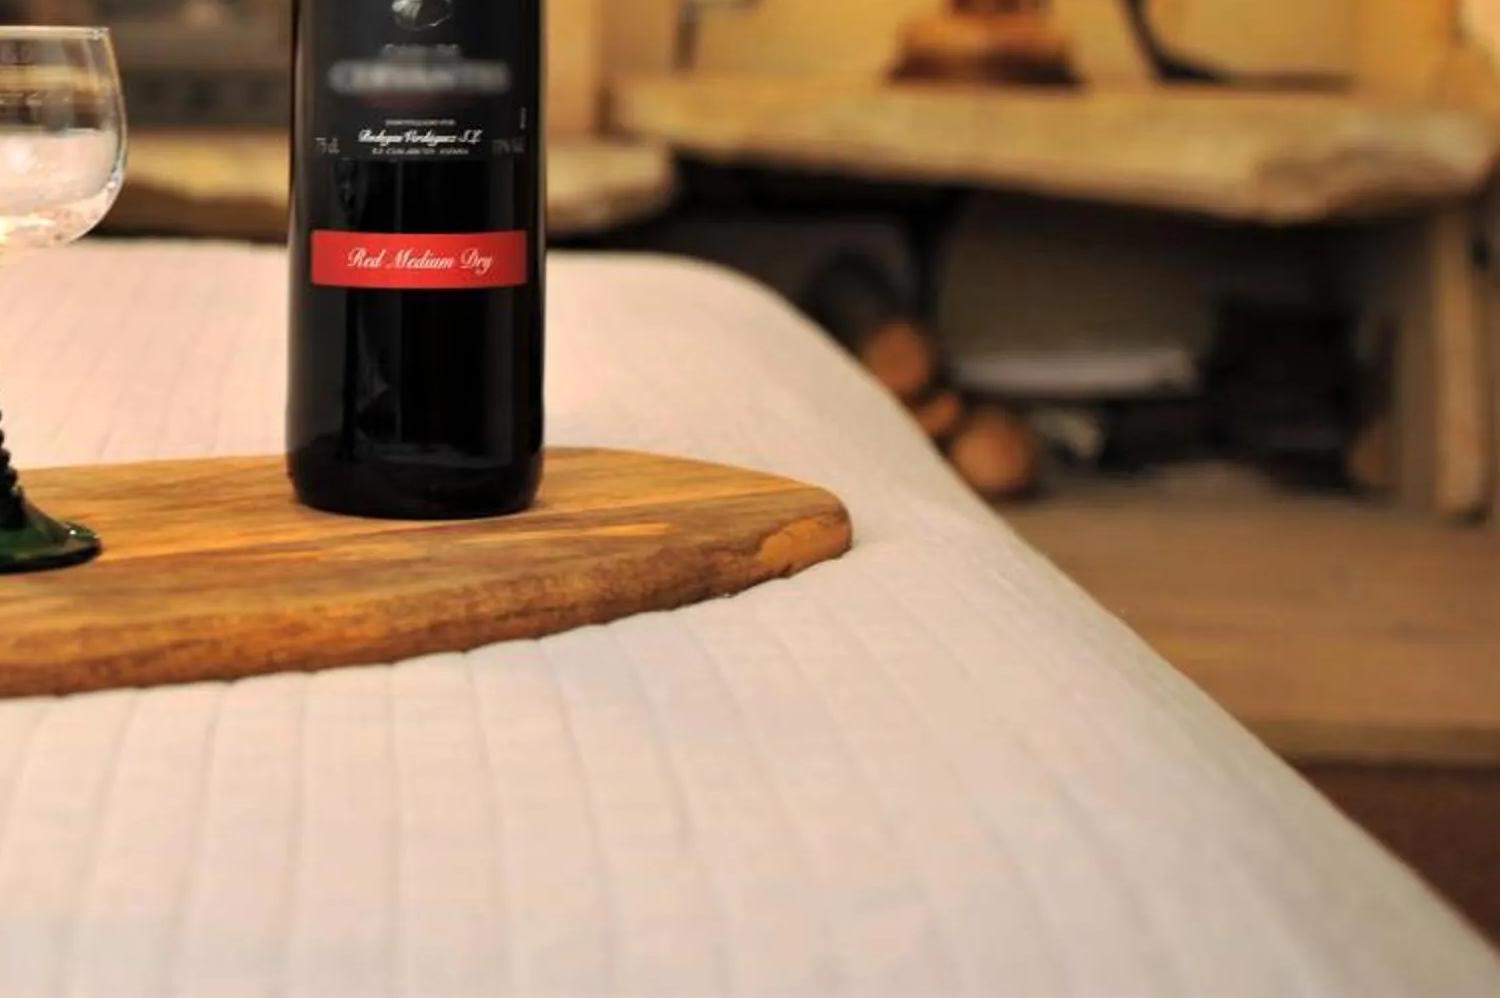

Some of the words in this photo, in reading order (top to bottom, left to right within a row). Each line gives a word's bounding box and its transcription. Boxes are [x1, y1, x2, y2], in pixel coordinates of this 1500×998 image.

[347, 247, 385, 269] Red
[386, 248, 454, 270] Medium
[460, 247, 494, 276] Dry
